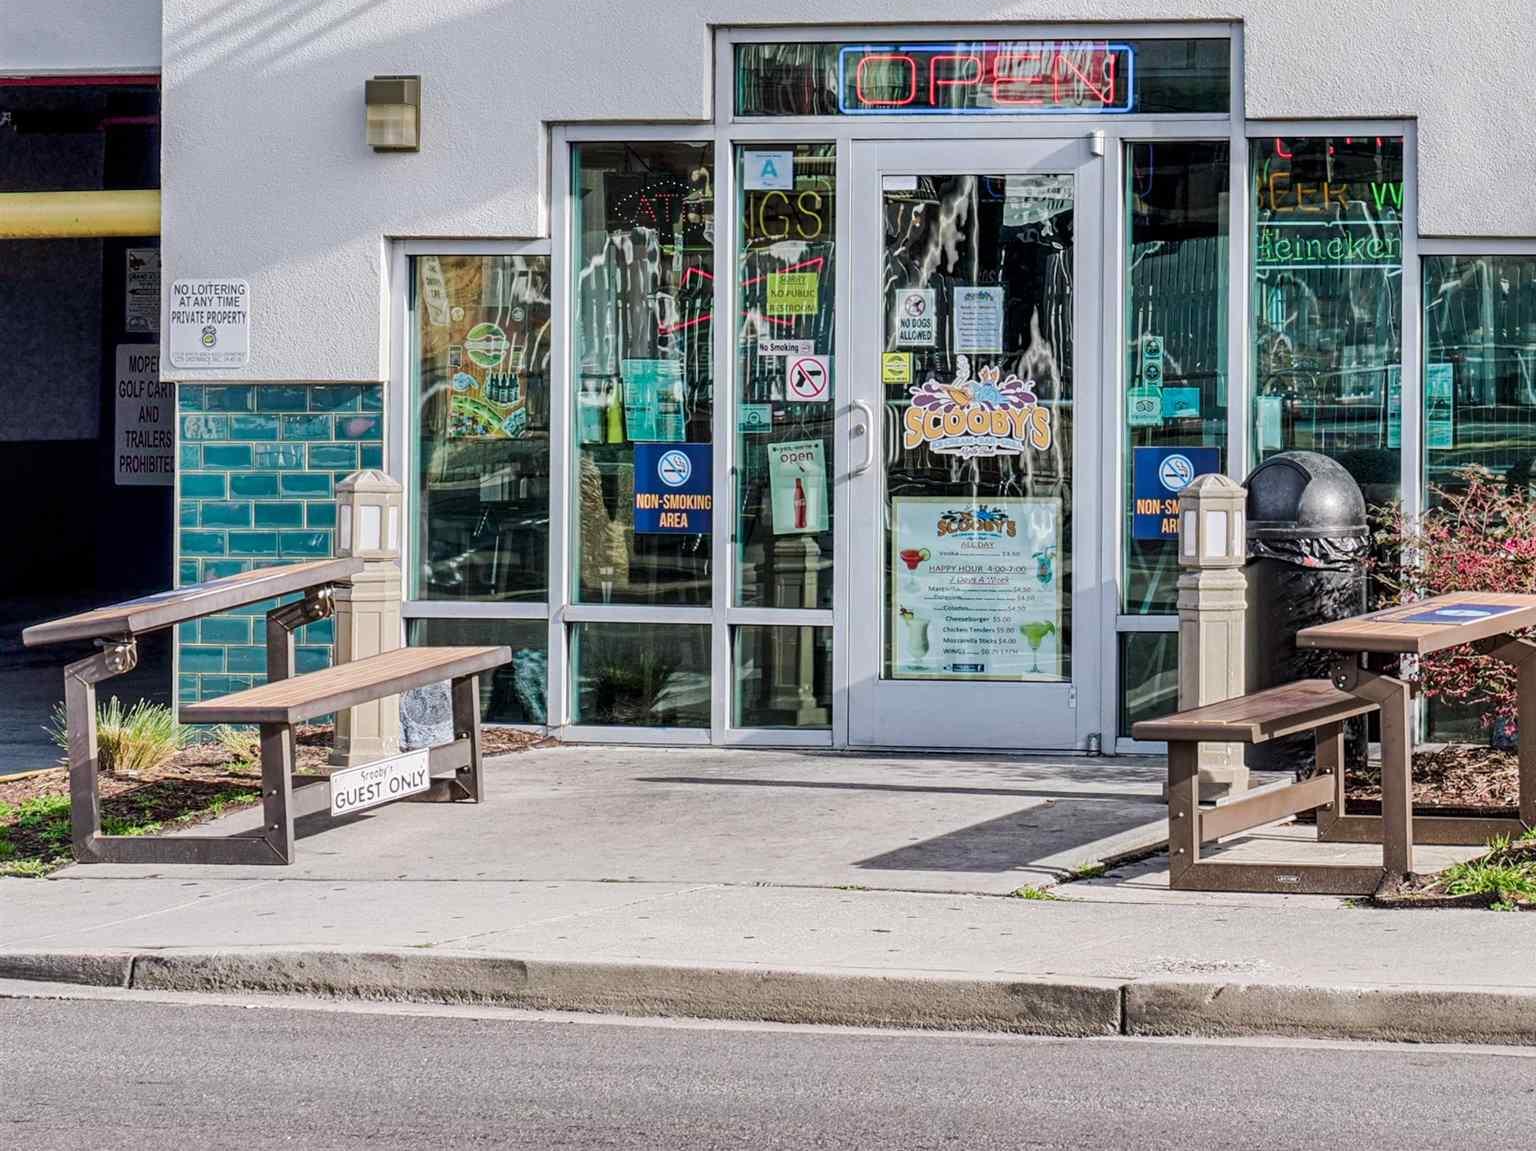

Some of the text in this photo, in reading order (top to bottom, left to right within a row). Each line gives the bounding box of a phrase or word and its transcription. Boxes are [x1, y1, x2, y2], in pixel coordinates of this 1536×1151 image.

[856, 54, 1115, 105] OPEN
[761, 159, 778, 177] A
[174, 284, 246, 295] NO LOITERING
[179, 297, 240, 307] AT ANY TIME
[171, 311, 247, 324] PRIVATE PROPERTY
[900, 319, 931, 328] NO DOGS
[900, 331, 932, 340] ALLOWED
[770, 344, 799, 353] Smoking
[119, 380, 175, 399] GOLF CART
[138, 406, 160, 423] AND
[125, 431, 172, 448] TRAILERS
[780, 452, 814, 464] open
[636, 494, 712, 510] NON-SMOKING
[659, 513, 688, 528] AREA
[335, 769, 425, 808] GUEST ONLY
